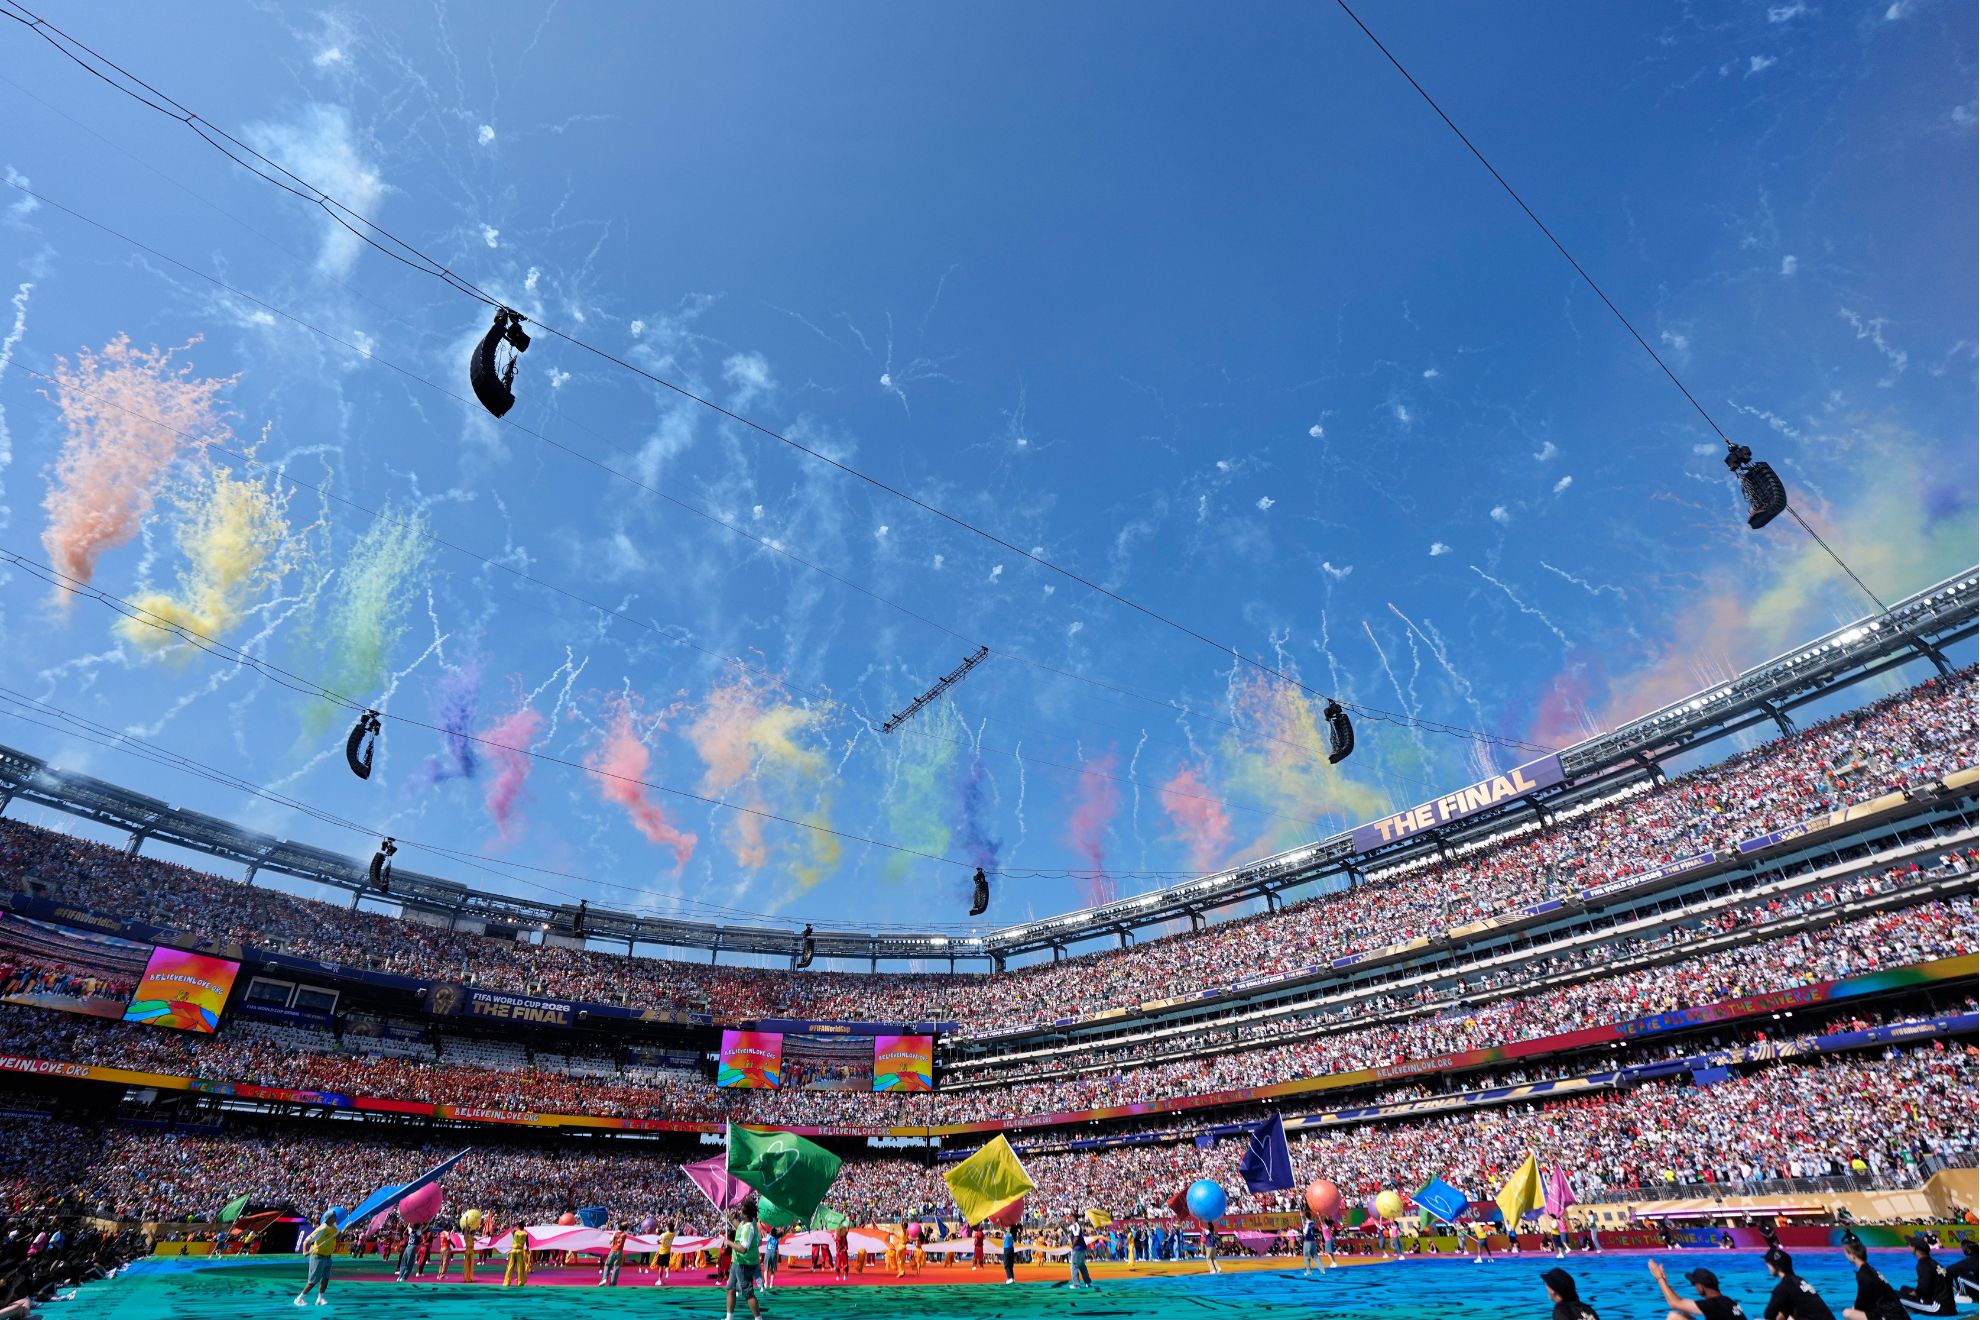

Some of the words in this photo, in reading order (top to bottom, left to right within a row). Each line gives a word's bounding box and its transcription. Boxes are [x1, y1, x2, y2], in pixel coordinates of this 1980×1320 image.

[1374, 804, 1436, 842] THE
[1437, 769, 1537, 820] FINAL
[1590, 887, 1604, 897] FIFA
[1604, 881, 1627, 894] WORLD
[1627, 877, 1640, 888] CUP
[1640, 870, 1663, 883] 2026
[1664, 865, 1680, 875] THE
[1680, 858, 1706, 870] FINAL
[54, 907, 122, 932] #FIFAWorldCup
[150, 973, 224, 995] BELIEVEINLOVE.ORG
[1247, 980, 1262, 988] WORLD
[1261, 977, 1270, 985] CUP
[1296, 968, 1312, 977] FINAL
[473, 992, 491, 1002] FIFA
[493, 995, 523, 1006] WORLD
[524, 1000, 541, 1008] CUP
[541, 1002, 570, 1012] 2026
[1615, 1023, 1637, 1034] WE
[1639, 1018, 1662, 1031] ARE
[1663, 1012, 1685, 1026] ALL
[1685, 1009, 1712, 1021] ONE
[1727, 1001, 1756, 1014] THE
[1757, 989, 1822, 1008] UNIVERSE
[472, 1001, 510, 1017] THE
[511, 1006, 568, 1025] FINAL
[809, 1024, 851, 1034] #FIFAWorldCup
[976, 1031, 989, 1039] NEW
[1376, 1058, 1453, 1077] BELIEVEINLOVE.ORG
[1378, 1103, 1414, 1115] THE
[1414, 1096, 1467, 1109] FINAL
